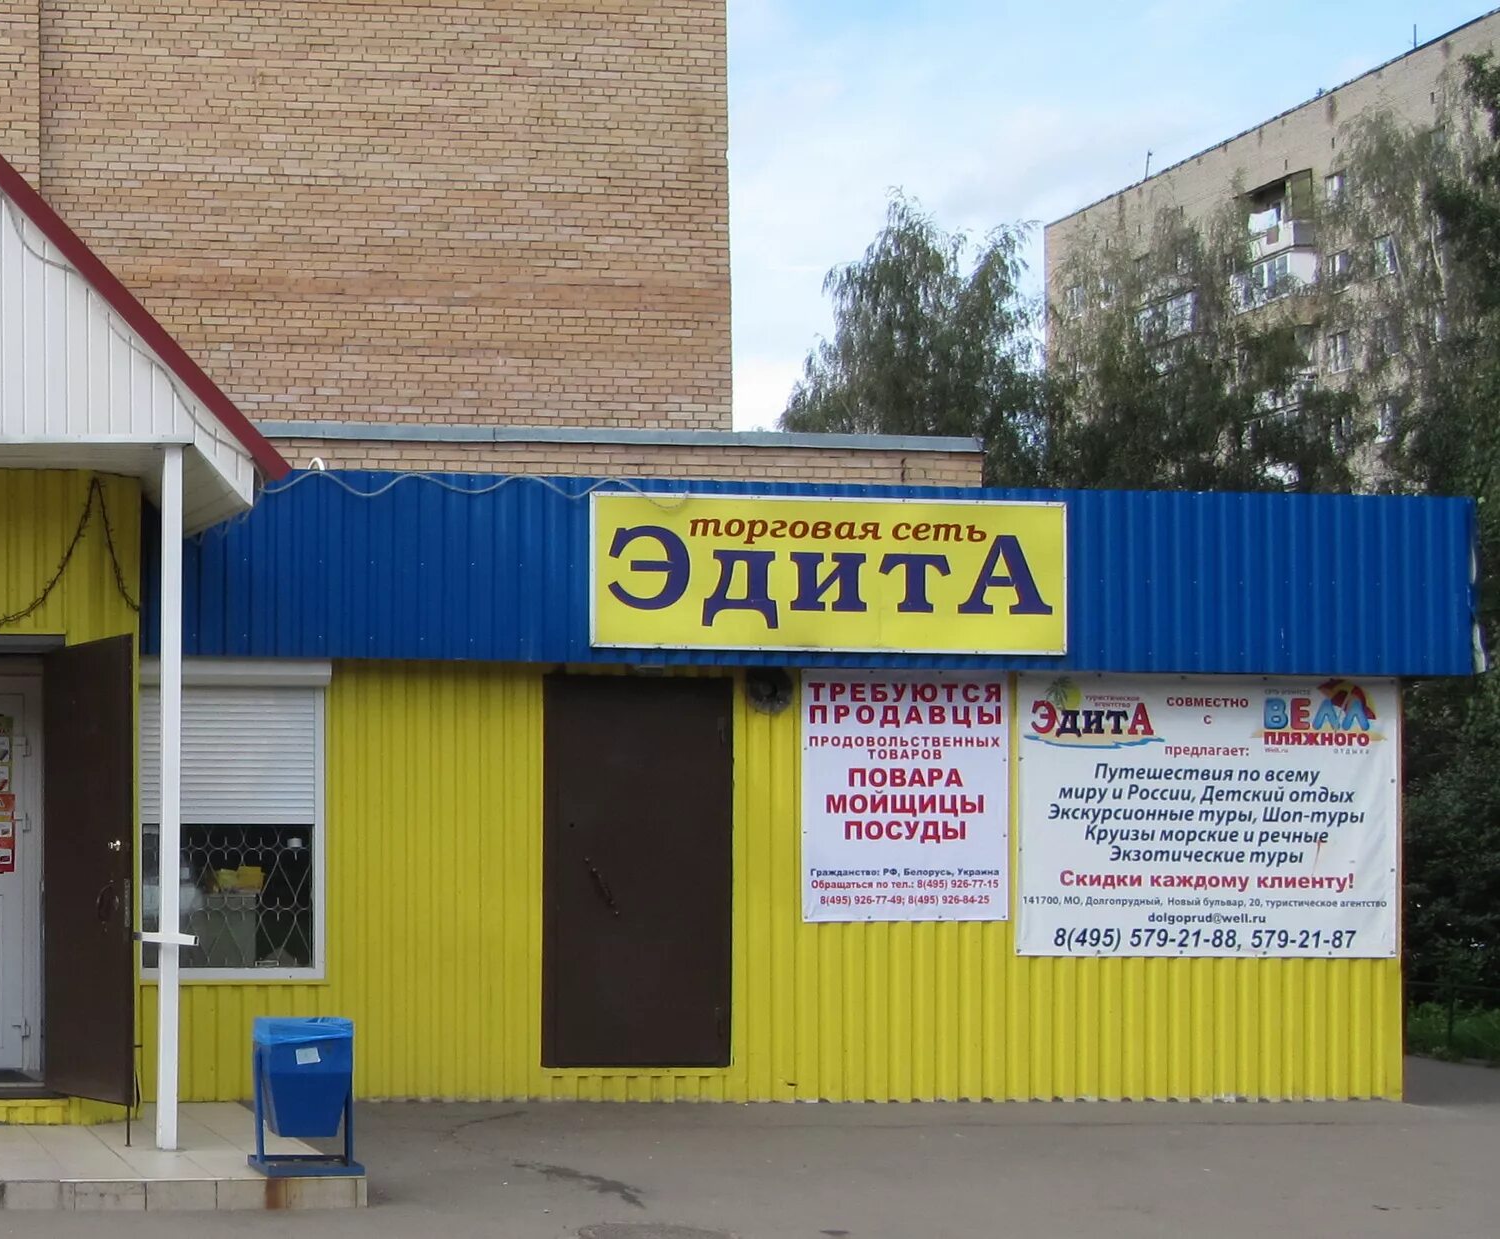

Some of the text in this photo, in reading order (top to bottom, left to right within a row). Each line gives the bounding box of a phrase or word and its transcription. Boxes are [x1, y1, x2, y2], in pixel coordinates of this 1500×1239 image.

[689, 517, 988, 544] торговая сеть
[607, 525, 1054, 630] ЭдитА
[808, 683, 1001, 703] ТРЕБУЮТСЯ
[1167, 697, 1249, 708] СОВМЕСТНО
[809, 705, 1001, 728] ПРОДАВЦЫ
[1031, 700, 1154, 738] ЭдитА
[809, 736, 1000, 749] ПРОДОВОЛЬСТВЕННЫХ
[1264, 731, 1370, 747] ПЛЯЖНОГО
[868, 749, 942, 760] ТОВАРОВ
[1165, 745, 1249, 758] предлагает:
[848, 768, 963, 787] ПОВАРА
[1094, 763, 1320, 786] Путешествия по всему
[826, 790, 984, 817] МОЙЩИЦЫ
[1059, 784, 1355, 804] миру и России, Детский отдых
[1048, 803, 1364, 827] Экскурсионные туры, Шоп-туры
[844, 821, 966, 844] ПОСУДЫ
[1085, 825, 1329, 847] Круизы морские и речные
[1109, 845, 1303, 867] Экзотические туры
[810, 868, 880, 877] Гражданство:
[882, 868, 900, 877] РФ,
[957, 868, 1000, 877] Украина
[1059, 870, 1354, 893] Скидки каждому клиенту!
[811, 880, 873, 889] Обращаться
[892, 880, 914, 888] тел.:
[917, 879, 948, 889] 8(495)
[951, 880, 999, 888] 926-77-15
[820, 895, 990, 905] 8(495) 926-77-49; 8(495) 926-84-25
[1023, 896, 1387, 908] 141700, МО, Долгопрудный, Новый бульвар, 20, туристическое агентство
[1148, 912, 1266, 924] dolgoprud@well.ru
[1054, 927, 1357, 951] 8(495) 579-21-88, 579-21-87
